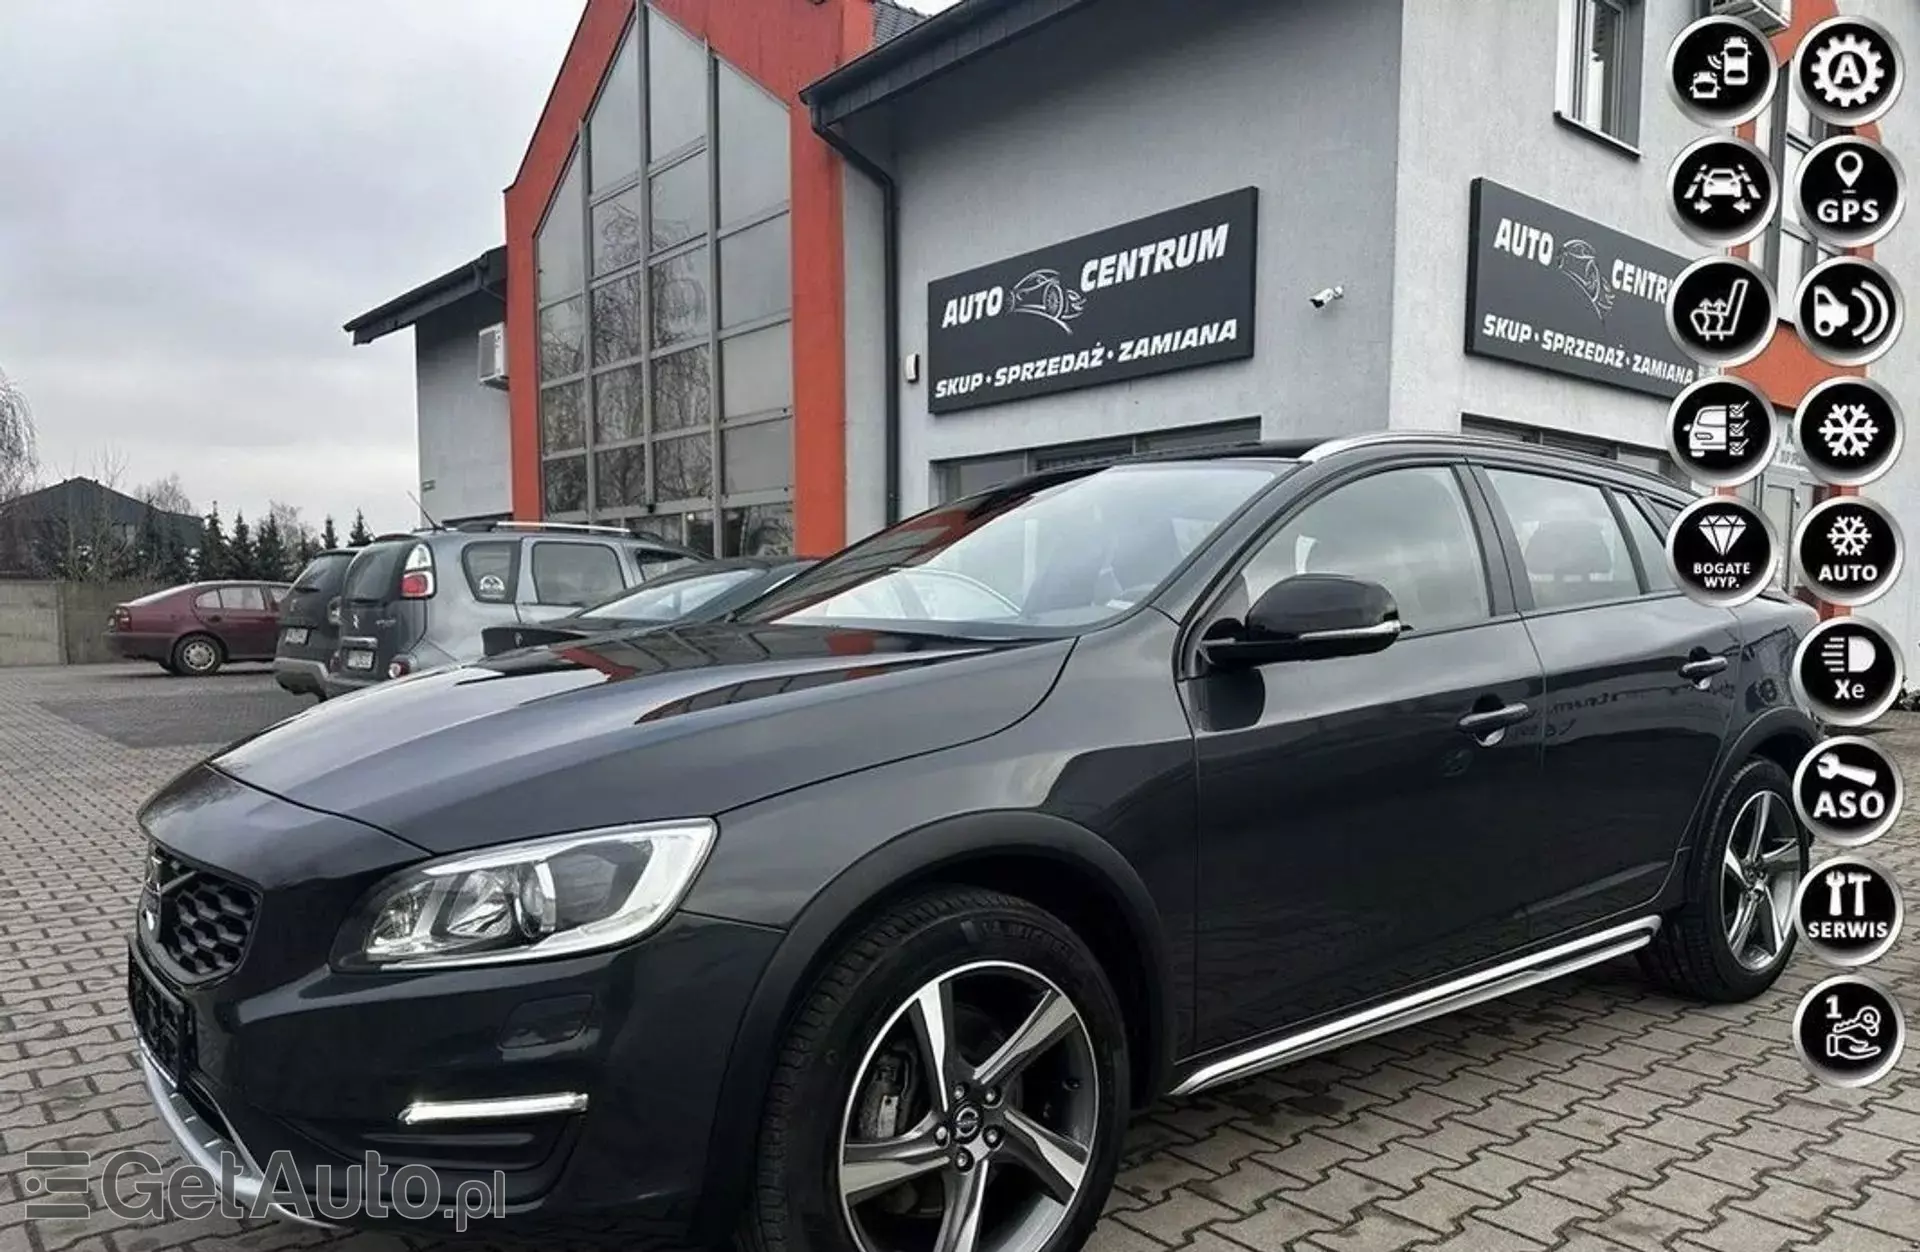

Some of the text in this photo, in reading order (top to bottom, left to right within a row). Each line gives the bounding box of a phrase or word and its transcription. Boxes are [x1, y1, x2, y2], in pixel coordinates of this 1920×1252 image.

[942, 224, 1230, 328] AUTO CENTRUM
[1494, 217, 1674, 304] AUTO CENTR
[935, 318, 1238, 398] SKUP SPRZEDAŻ ZAMIANA
[1482, 313, 1695, 385] SKUP SPRZEDAŻ ZAMIANA
